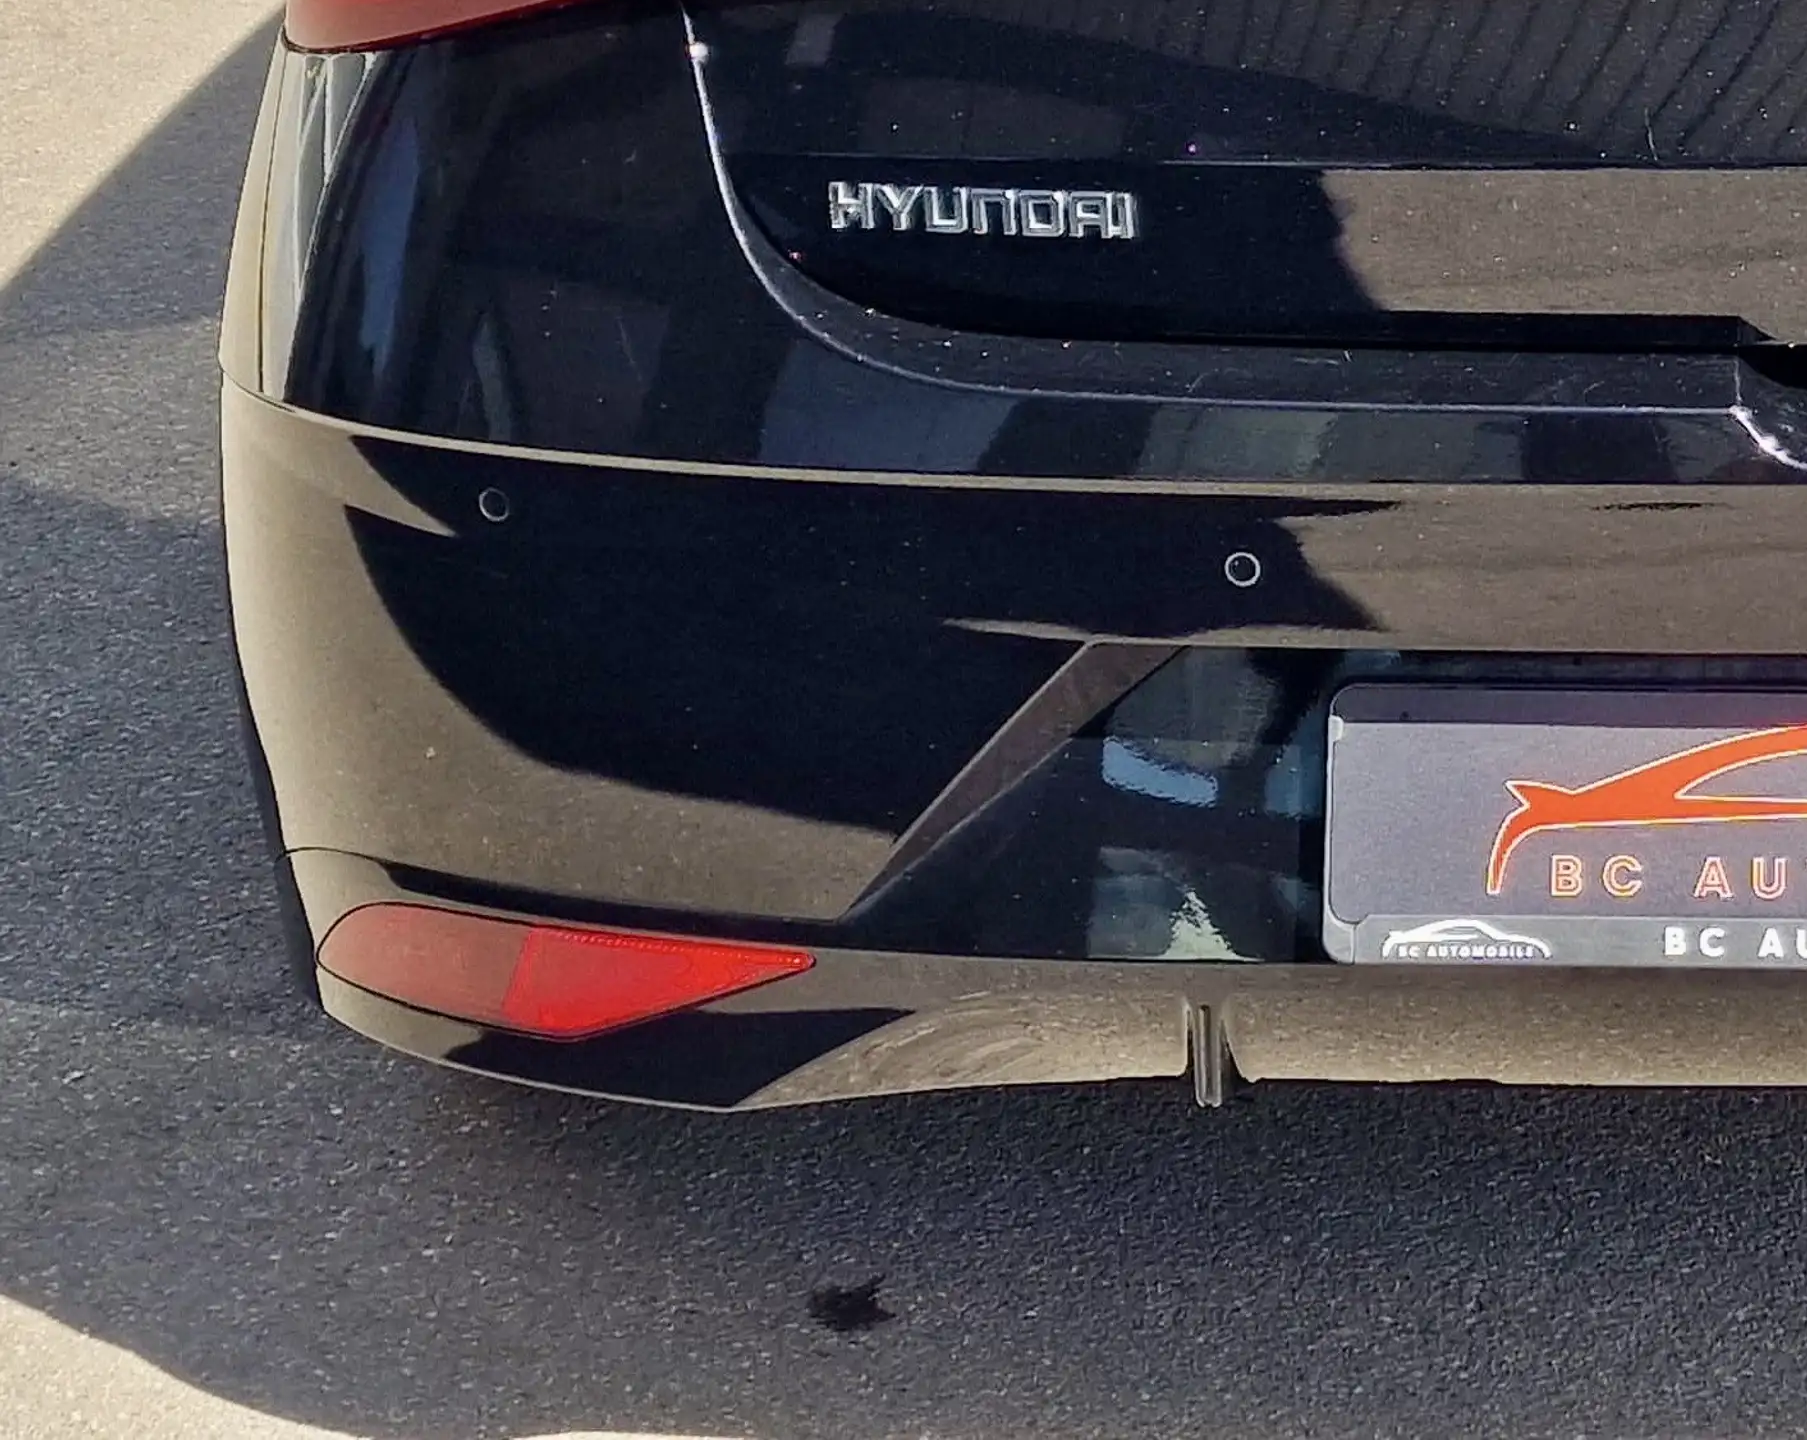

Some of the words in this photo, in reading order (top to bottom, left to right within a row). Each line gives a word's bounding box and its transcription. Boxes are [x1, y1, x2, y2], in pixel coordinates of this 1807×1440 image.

[828, 180, 1136, 239] HYUNDAI
[1551, 854, 1644, 897] BC
[1663, 926, 1726, 958] BC
